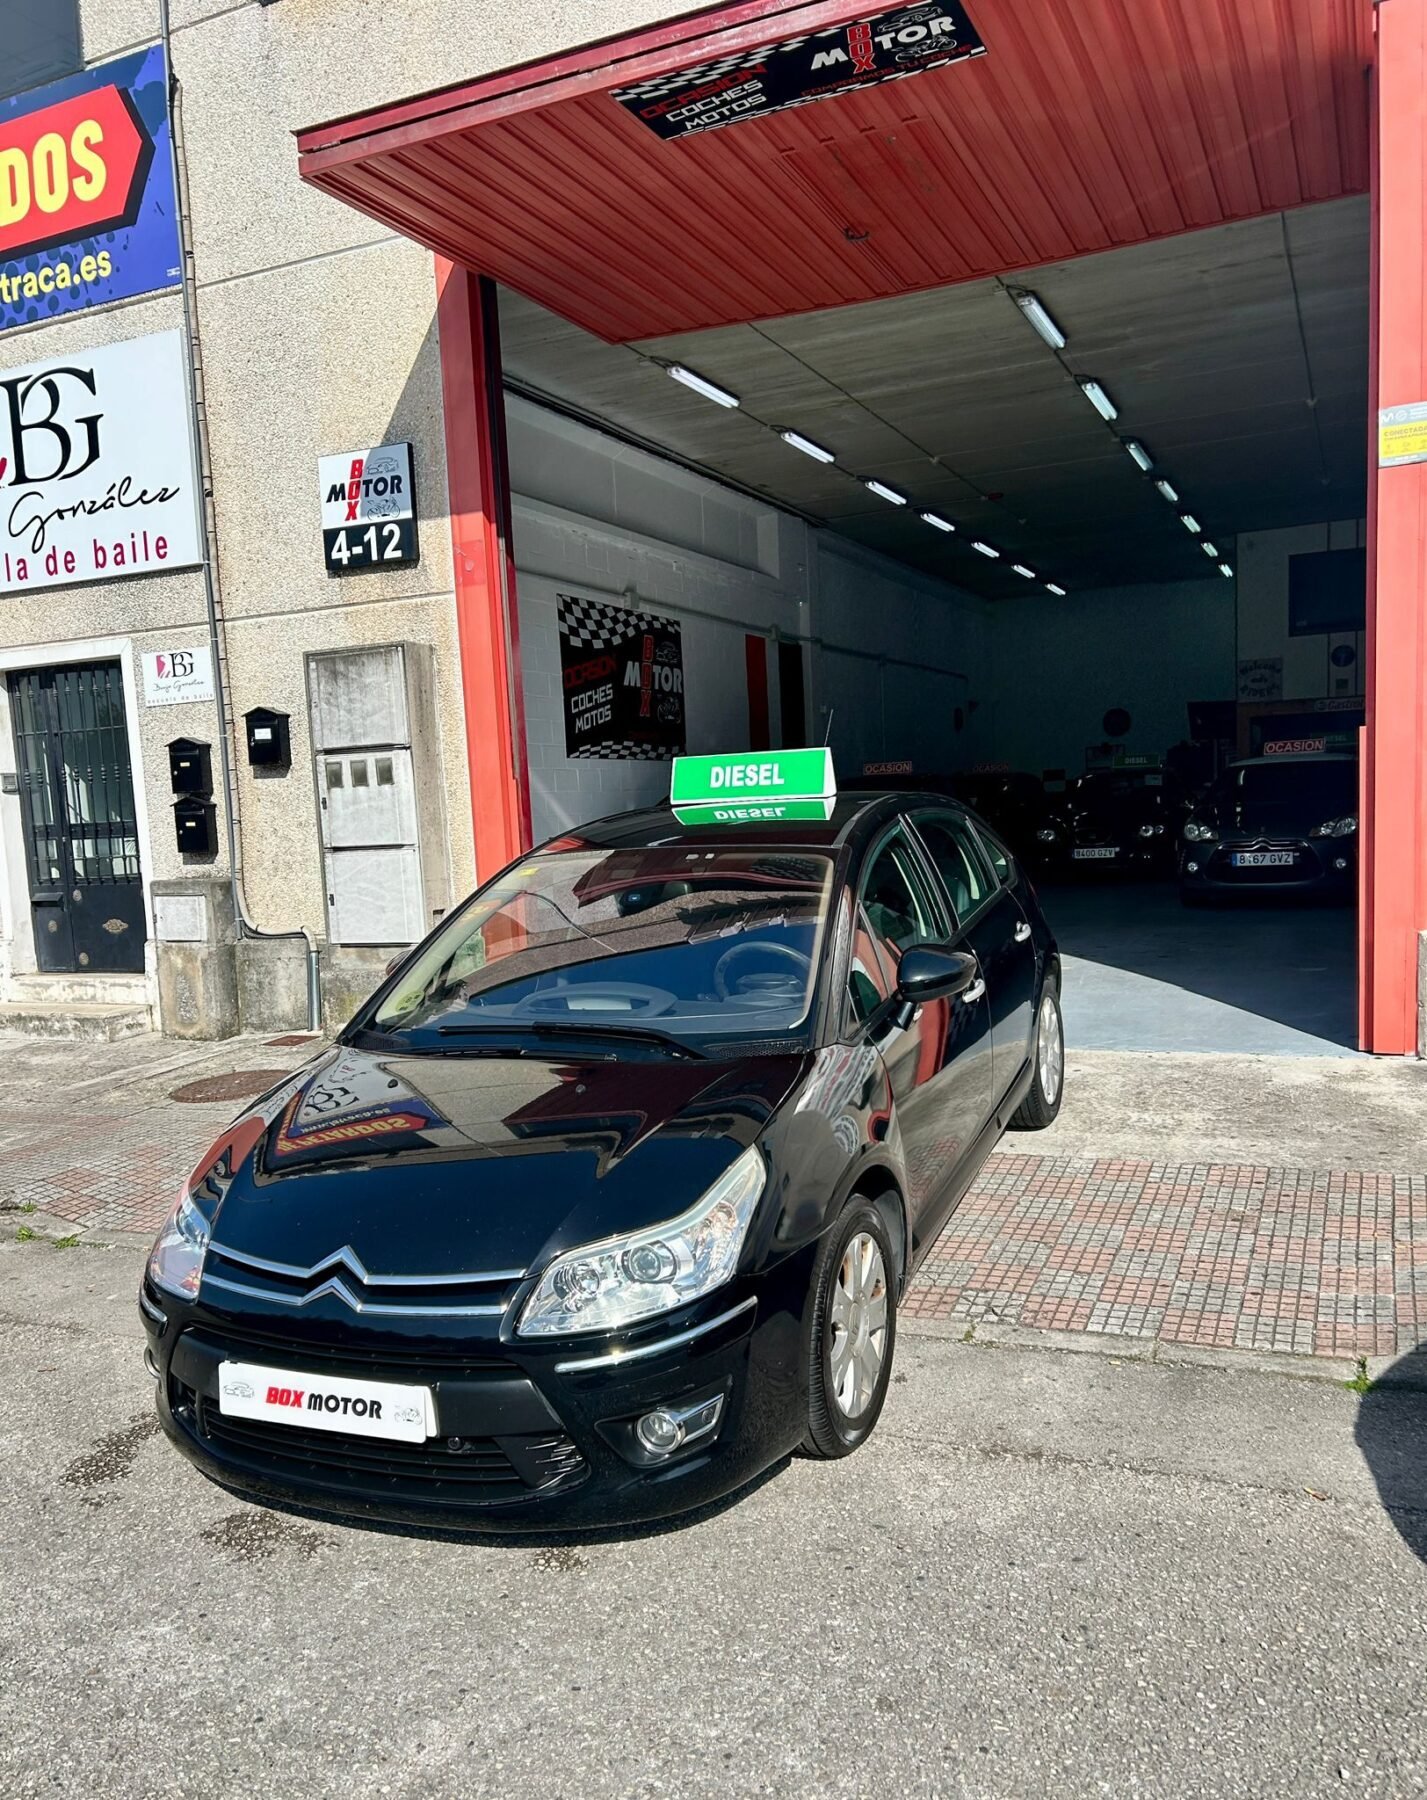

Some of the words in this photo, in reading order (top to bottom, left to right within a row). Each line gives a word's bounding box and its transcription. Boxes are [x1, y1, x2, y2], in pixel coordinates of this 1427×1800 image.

[845, 22, 876, 74] BOX
[665, 79, 764, 123] COCHES
[685, 93, 768, 130] MOTOS
[0, 250, 113, 304] traca.es
[345, 458, 364, 521] BOX
[8, 476, 180, 554] González
[45, 545, 76, 577] de
[93, 530, 168, 570] baile
[331, 522, 403, 565] 4-12
[168, 651, 195, 678] BG
[639, 633, 655, 718] BOX
[571, 682, 614, 714] COCHES
[575, 704, 612, 734] MOTOS
[1265, 740, 1324, 754] OCASION
[709, 762, 785, 789] DIESEL
[864, 762, 911, 774] OCASION
[1269, 853, 1291, 864] GVZ
[265, 1386, 304, 1408] BOX
[307, 1393, 382, 1420] MOTOR
